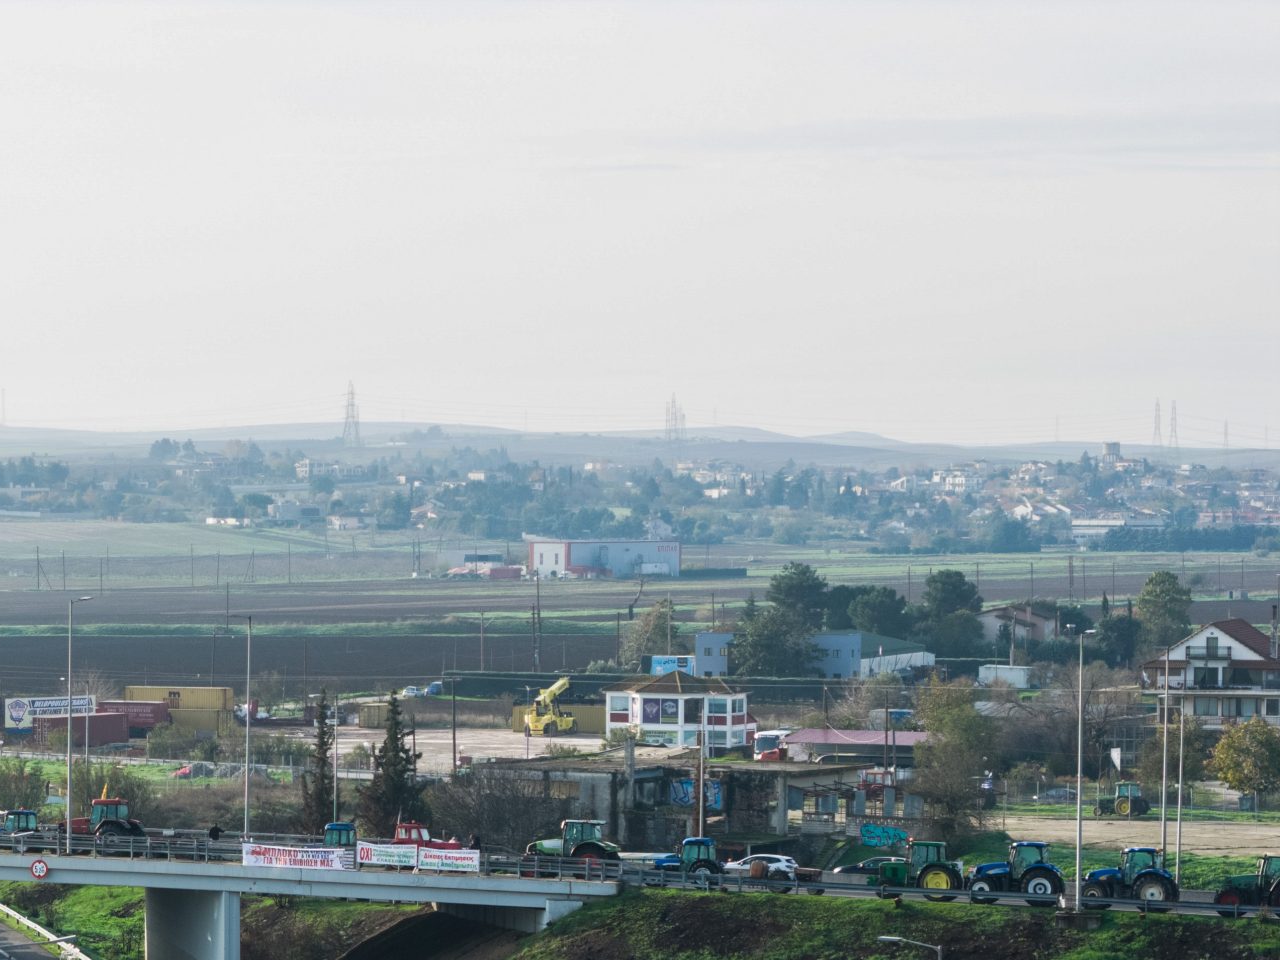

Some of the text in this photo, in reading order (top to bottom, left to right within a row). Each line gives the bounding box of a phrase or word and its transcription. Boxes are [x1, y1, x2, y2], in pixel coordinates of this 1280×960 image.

[265, 848, 298, 858] ΜΠΛΟΚΟ
[360, 847, 373, 861] ΟΧΙ
[275, 857, 287, 865] ΤΗΝ
[289, 858, 318, 867] ΕΠΙΒΙΩΣΗ
[320, 859, 334, 868] ΜΑΣ
